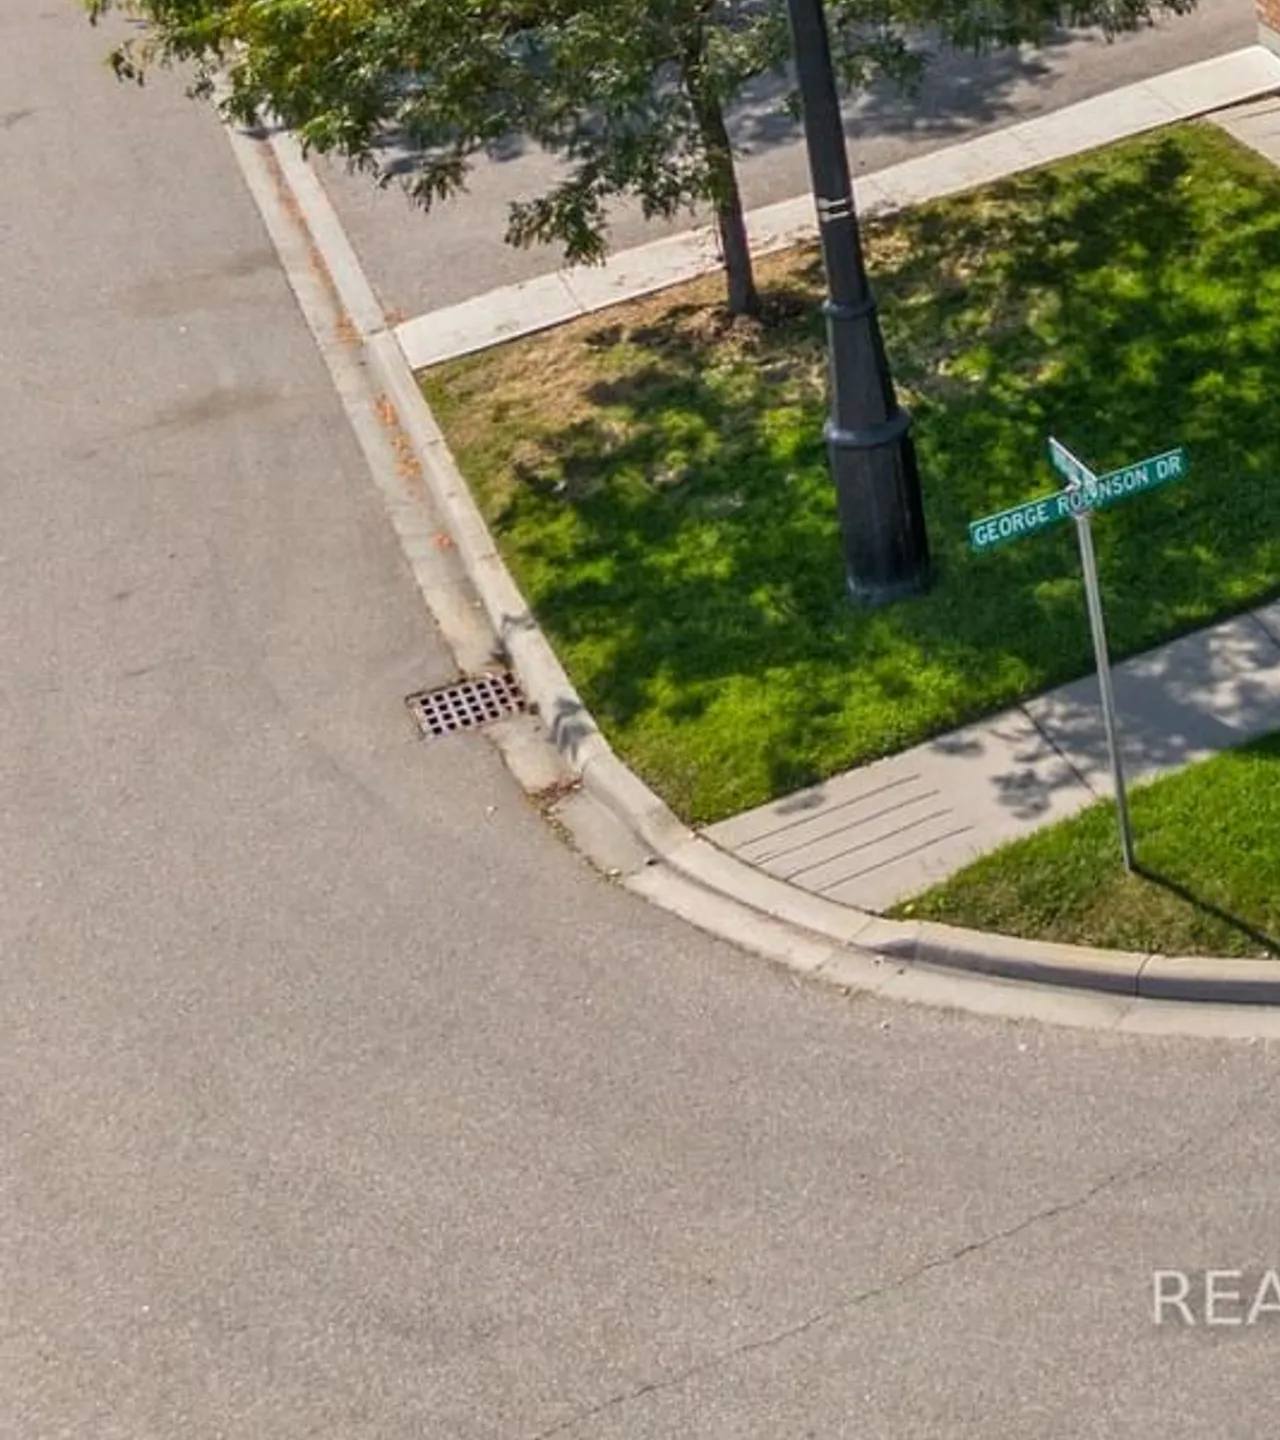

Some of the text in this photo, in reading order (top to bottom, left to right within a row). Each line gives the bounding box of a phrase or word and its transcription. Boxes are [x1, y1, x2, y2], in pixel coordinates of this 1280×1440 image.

[973, 455, 1182, 545] GEORGE ROBNSON DR
